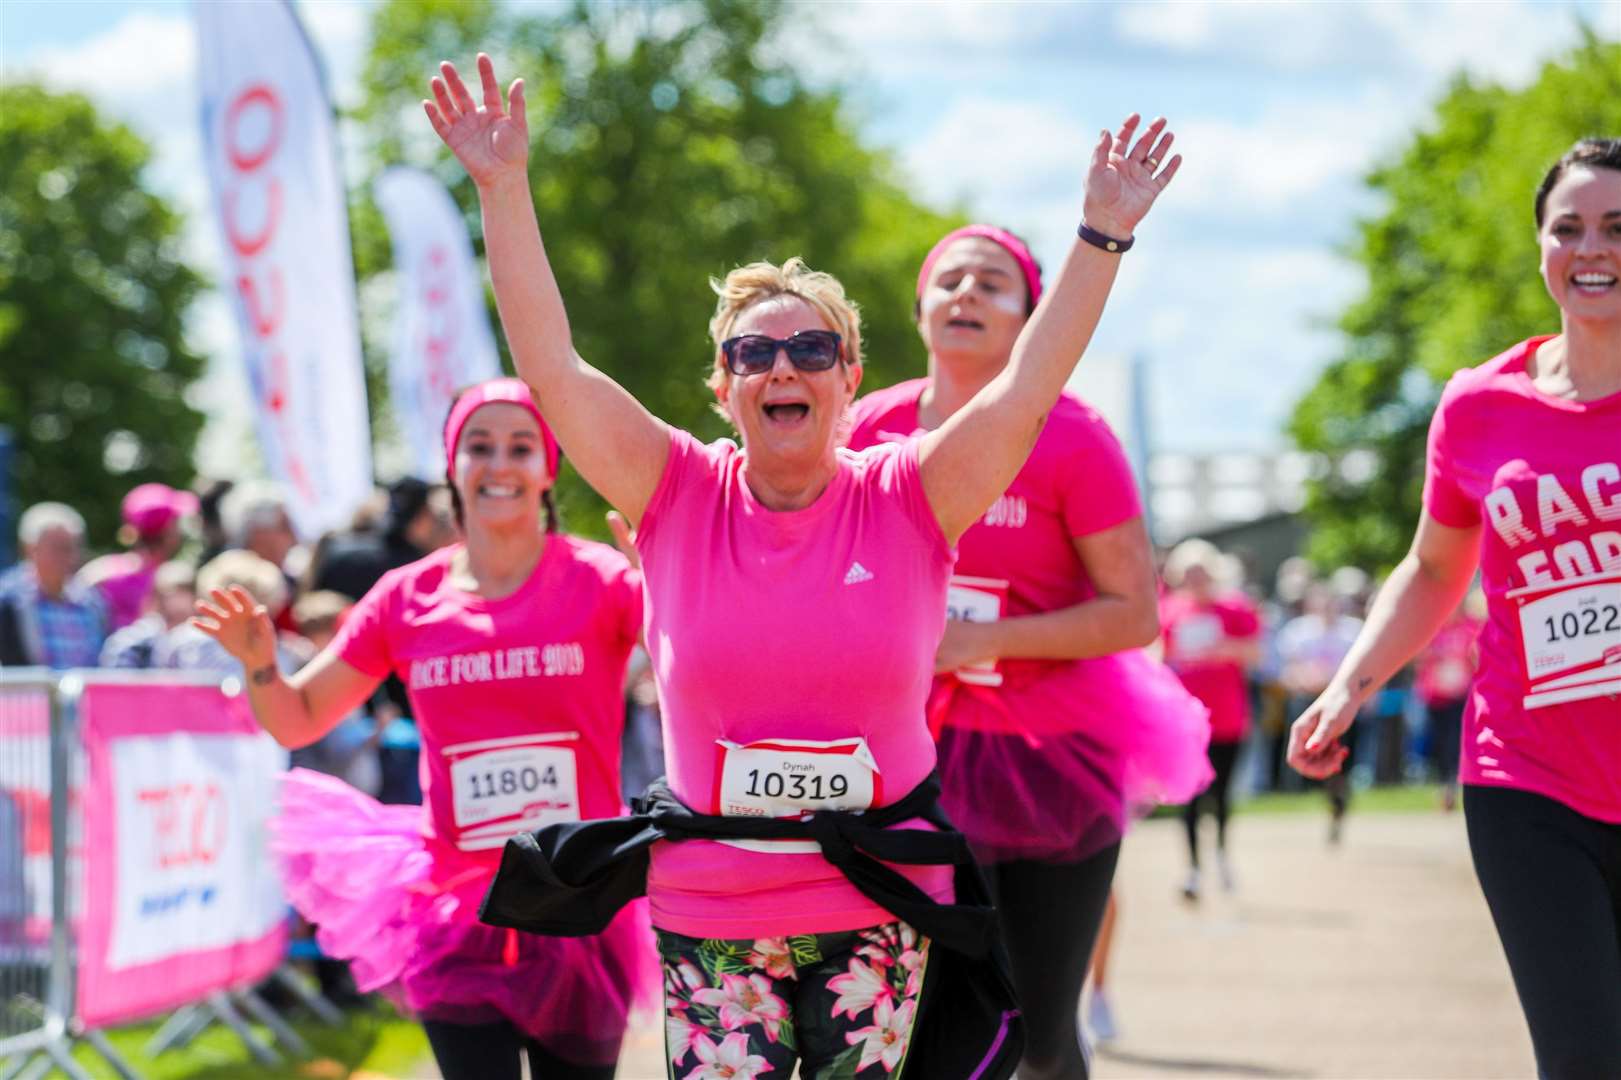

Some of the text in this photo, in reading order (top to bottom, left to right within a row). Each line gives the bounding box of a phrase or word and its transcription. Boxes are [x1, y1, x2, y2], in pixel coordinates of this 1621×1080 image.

[1485, 462, 1621, 549] RAC
[1544, 604, 1621, 643] 1022
[450, 651, 494, 685] FOR
[495, 646, 541, 680] LIFE
[470, 765, 559, 800] 11804
[745, 768, 849, 800] 10319
[782, 761, 816, 773] Dynah
